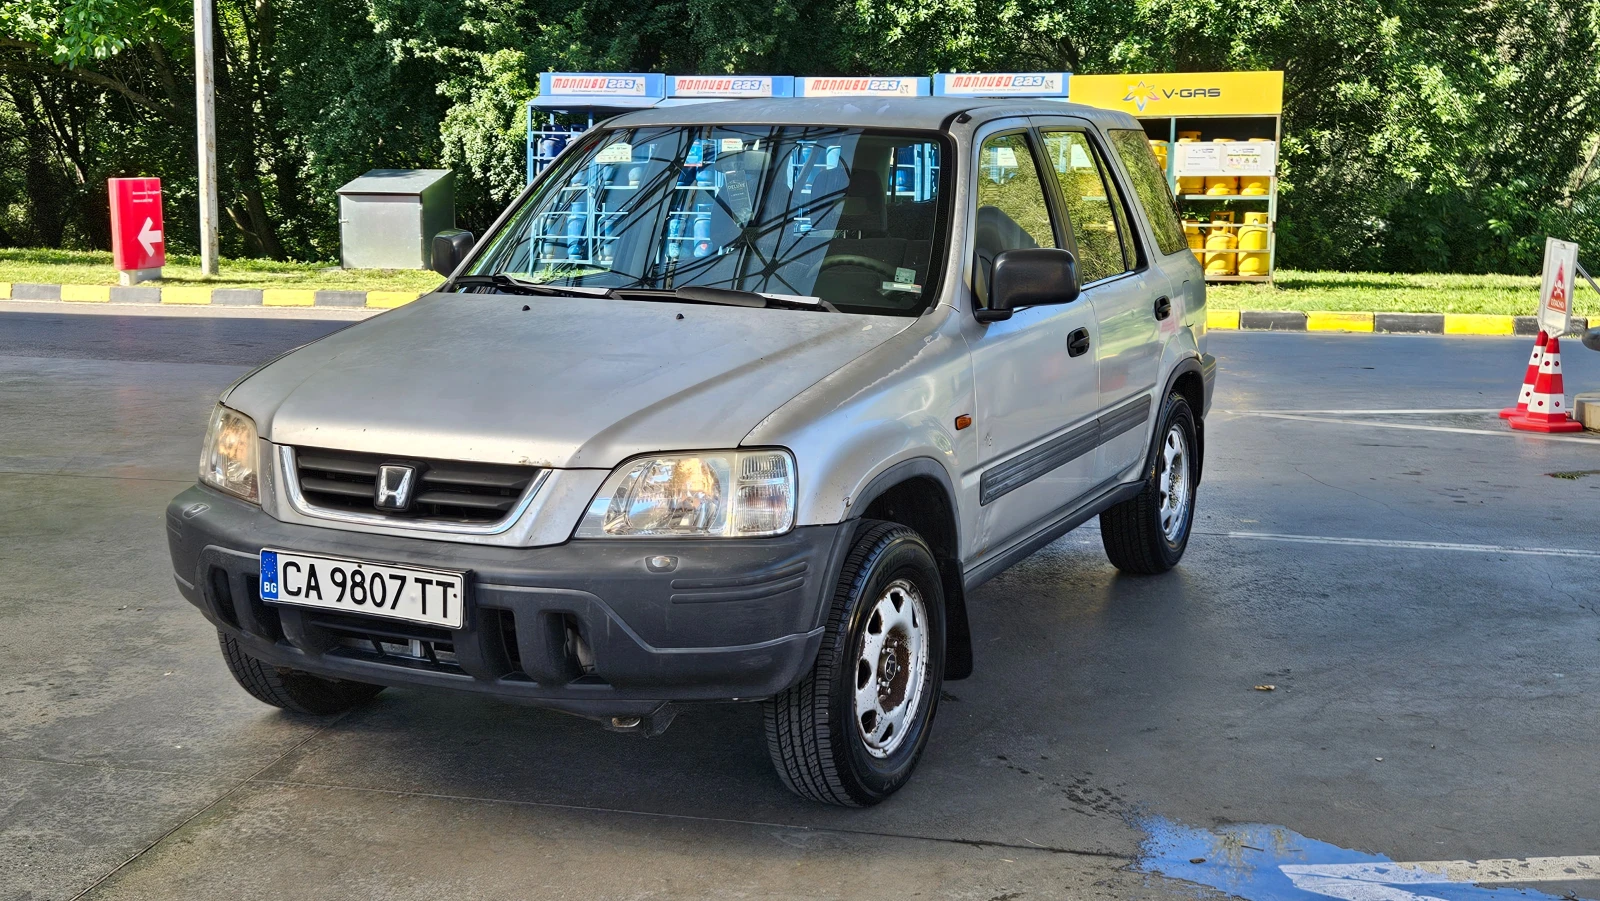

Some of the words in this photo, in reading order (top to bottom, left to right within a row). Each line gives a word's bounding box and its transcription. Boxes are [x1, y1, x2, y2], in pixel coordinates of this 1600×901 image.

[1162, 88, 1221, 99] V-GAS
[264, 582, 277, 593] BG
[283, 561, 323, 600] CA
[330, 567, 407, 610] 9807
[414, 577, 455, 618] TT
